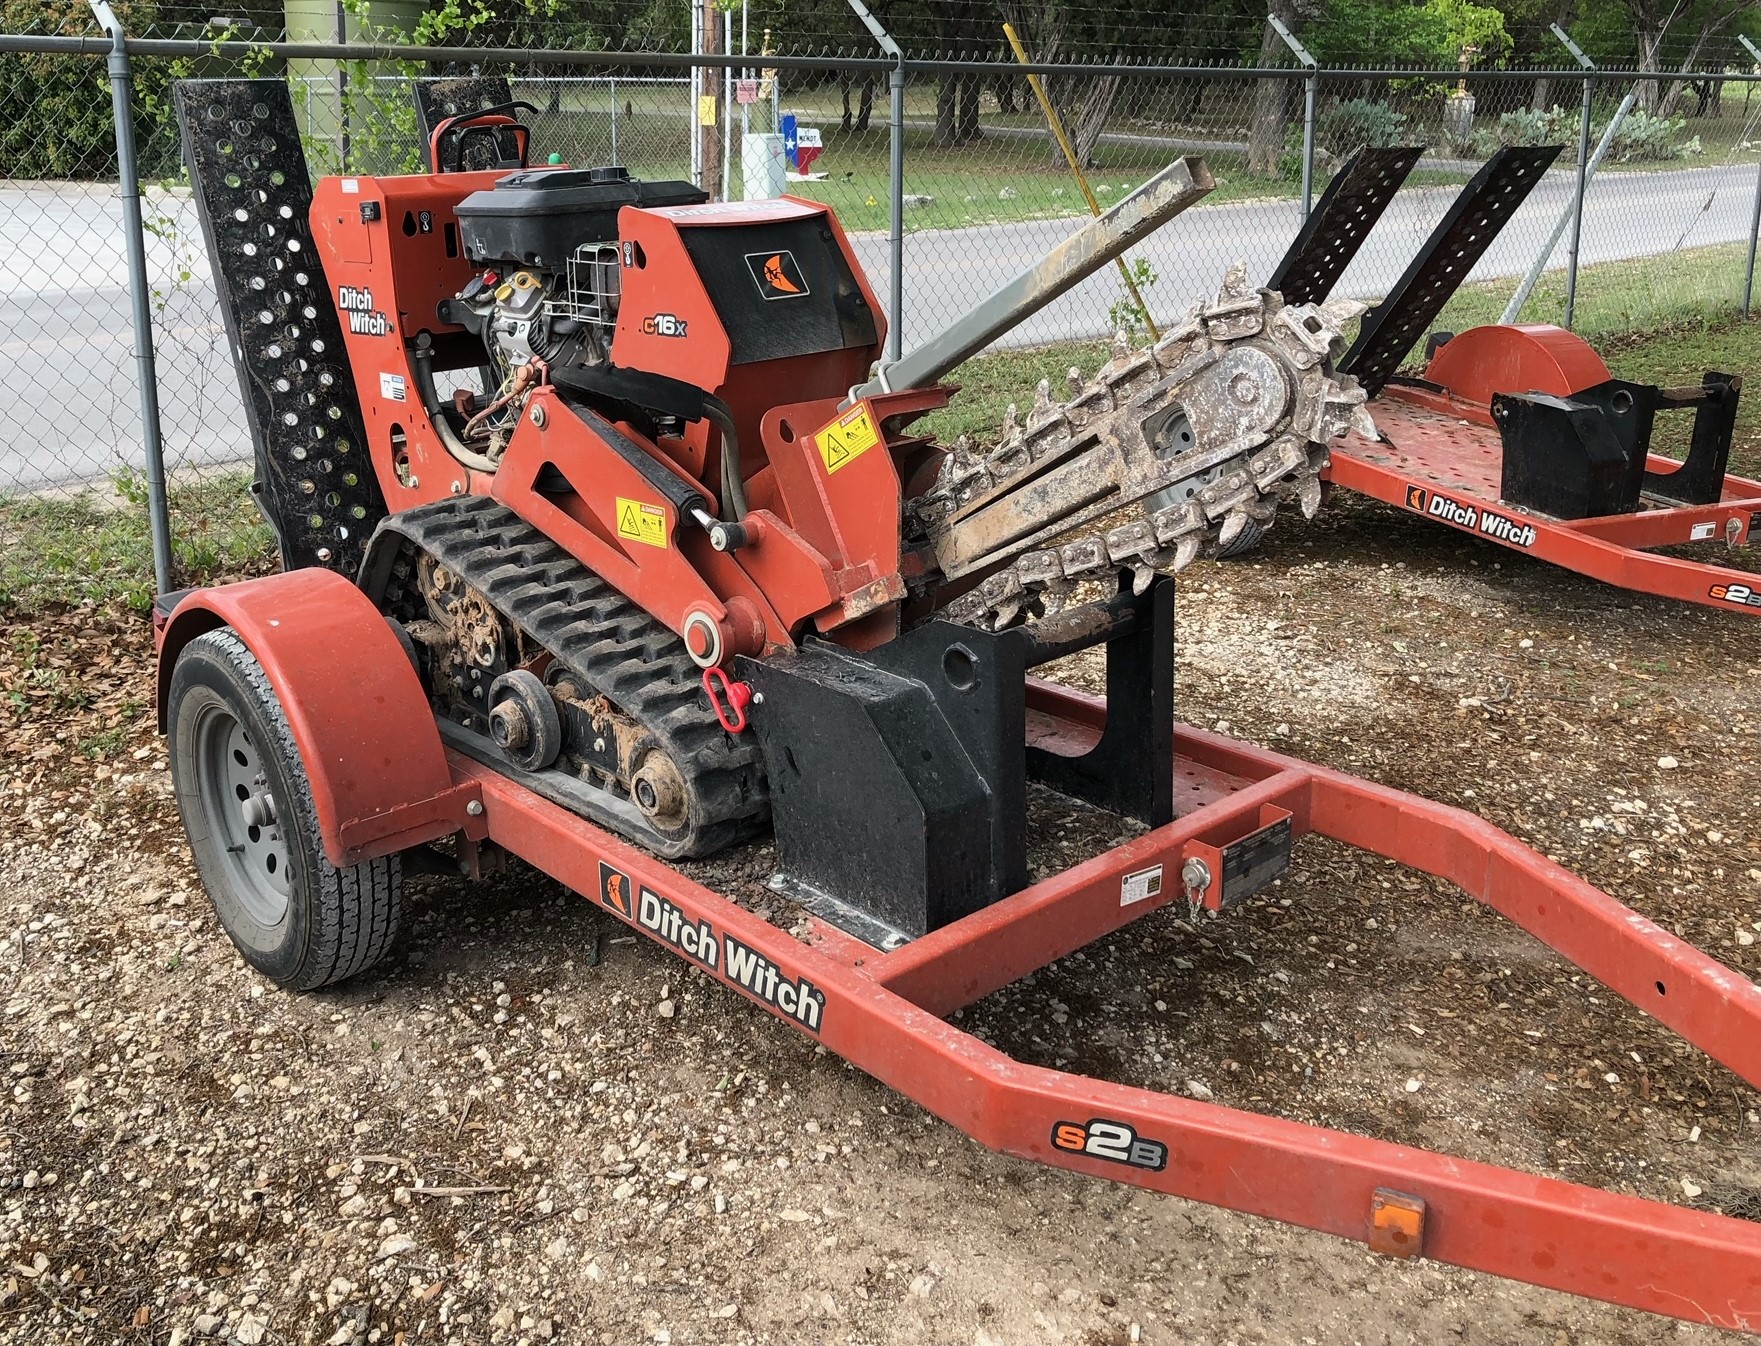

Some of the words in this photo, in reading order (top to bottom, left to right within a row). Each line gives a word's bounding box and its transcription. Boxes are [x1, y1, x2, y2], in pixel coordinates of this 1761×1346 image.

[339, 287, 372, 310] Ditch
[349, 311, 385, 335] Witch
[1428, 495, 1477, 528] Ditch
[1480, 511, 1536, 547] Witch
[1710, 584, 1761, 606] S2B
[638, 890, 719, 967] Ditch
[725, 939, 824, 1029] Witch
[1055, 1122, 1163, 1168] S2B
